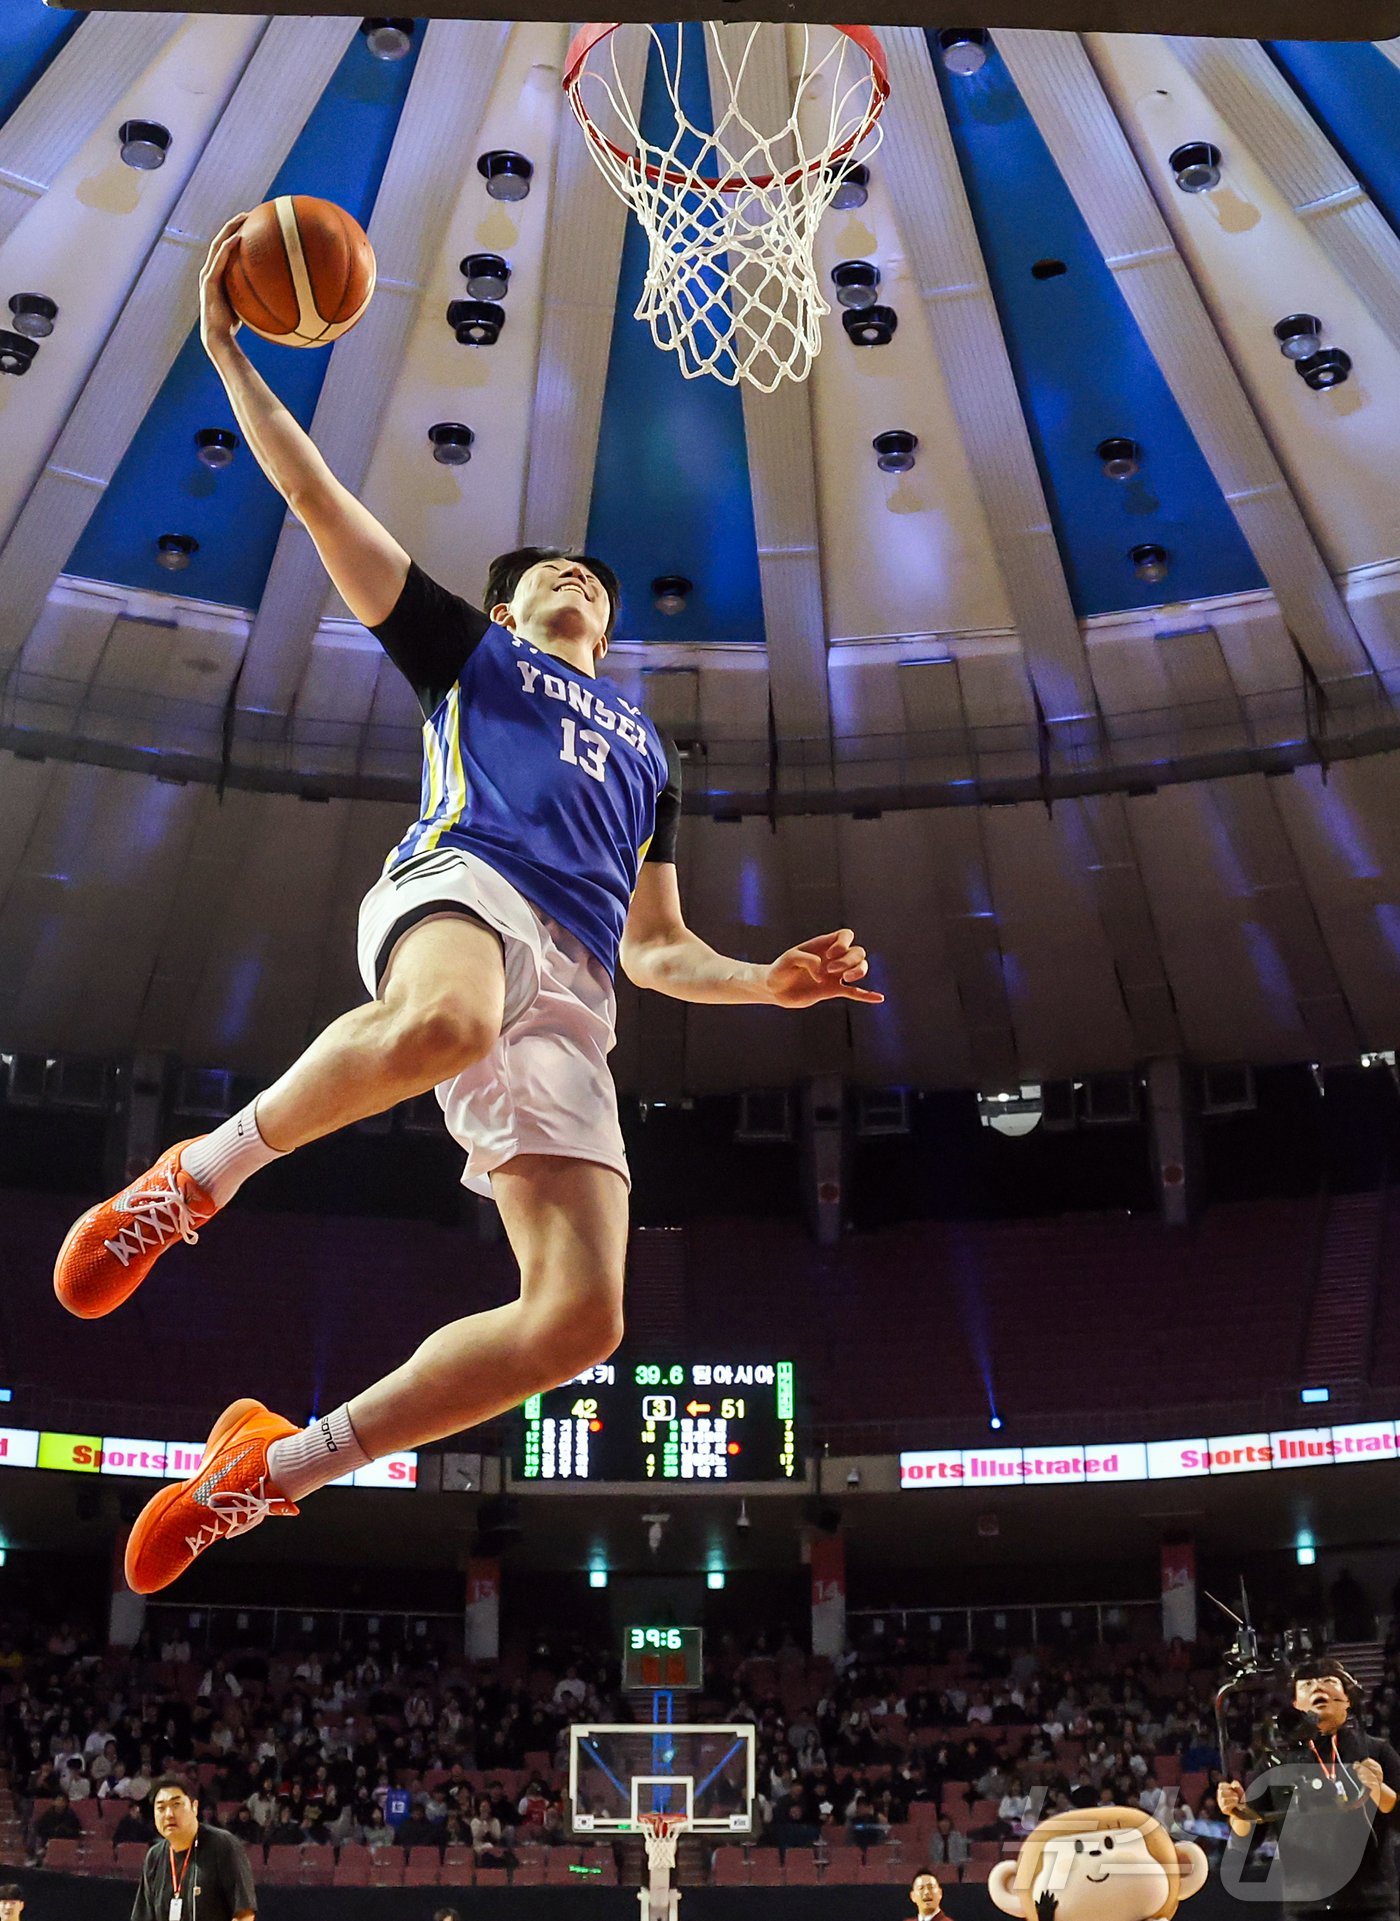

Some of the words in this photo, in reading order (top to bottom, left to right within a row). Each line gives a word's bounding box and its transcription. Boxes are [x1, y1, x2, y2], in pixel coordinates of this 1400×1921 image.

[516, 660, 647, 757] YONSEI
[559, 717, 611, 783] 13
[634, 1365, 685, 1386] 39.6
[692, 1364, 775, 1386] 팀아시아
[571, 1398, 598, 1419] 42
[651, 1399, 667, 1418] 3
[721, 1398, 745, 1419] 51
[72, 1445, 168, 1470] Sports
[970, 1454, 1119, 1478] Illustrated
[1180, 1446, 1275, 1469] Sports
[631, 1628, 682, 1649] 39:6
